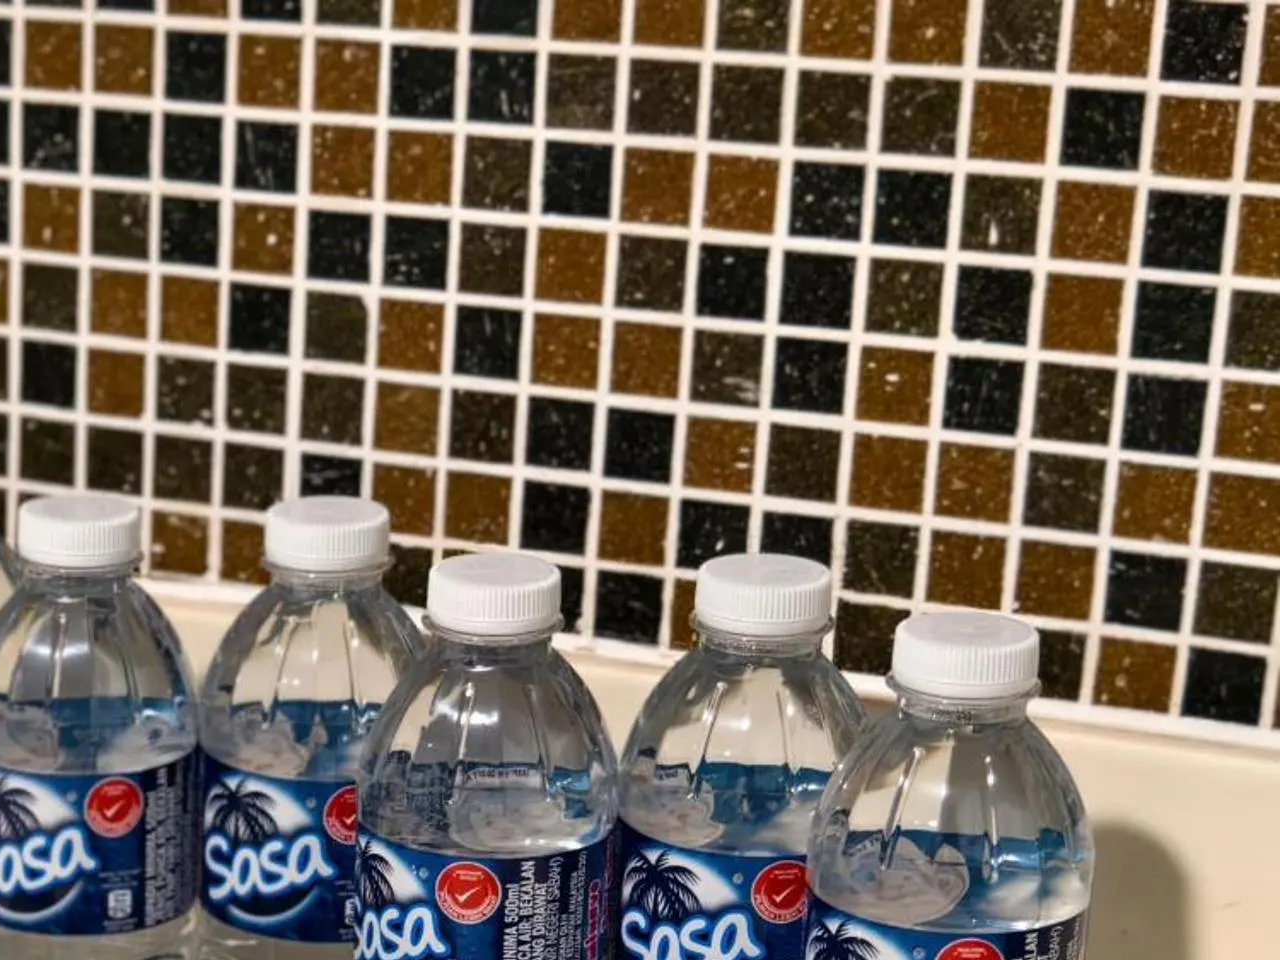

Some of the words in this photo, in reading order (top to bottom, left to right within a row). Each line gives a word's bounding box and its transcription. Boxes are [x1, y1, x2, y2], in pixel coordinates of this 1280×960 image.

[204, 834, 334, 900] Sasa
[520, 860, 536, 917] BEKALAN
[505, 883, 520, 923] 500ml
[533, 882, 547, 935] DIRAWAT
